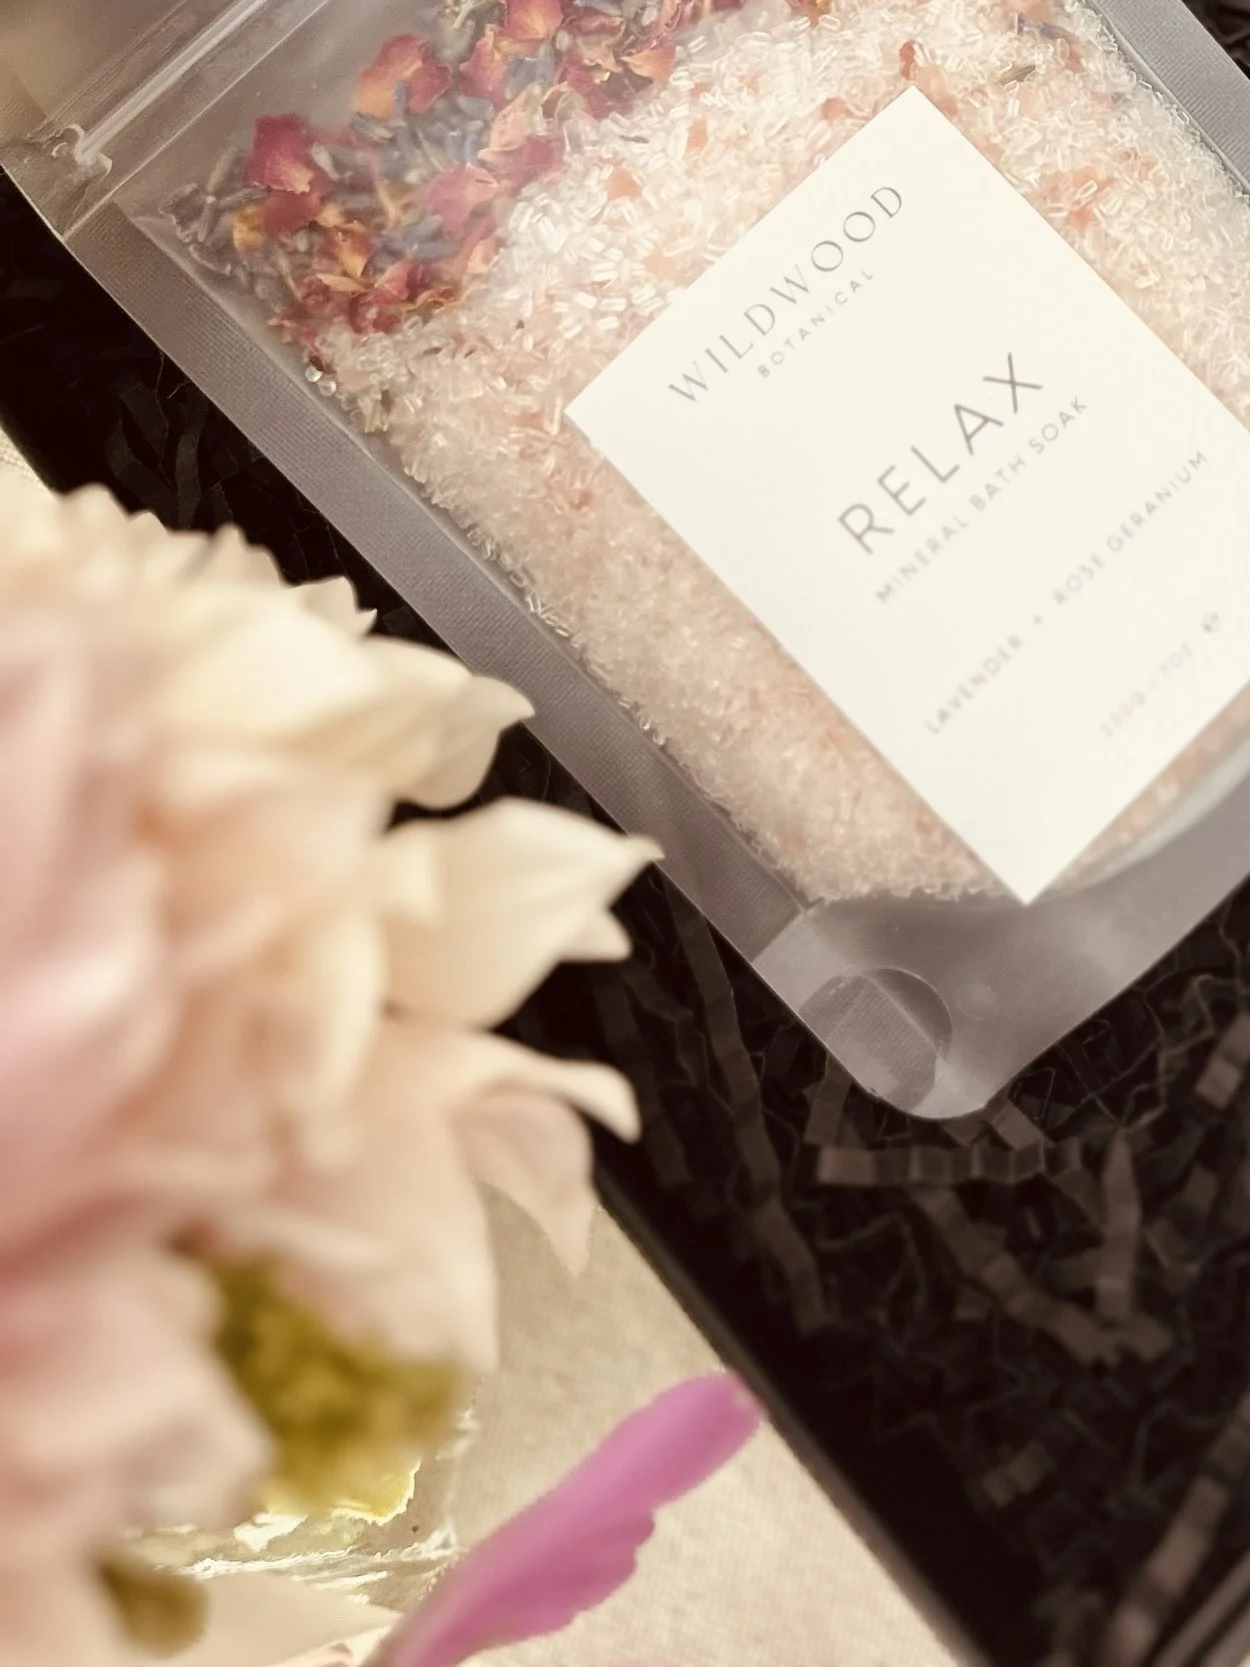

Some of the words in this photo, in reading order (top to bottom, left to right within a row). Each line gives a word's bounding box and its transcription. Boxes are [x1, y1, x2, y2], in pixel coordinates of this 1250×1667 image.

[667, 186, 903, 403] WILDWOOD
[757, 269, 875, 378] BOTANICAL
[836, 350, 1044, 556] RELAX
[875, 514, 970, 604] MINERAL
[969, 454, 1027, 513] BATH
[1028, 395, 1088, 455] SOAK
[925, 633, 1023, 736] LAVENDER
[1052, 551, 1105, 606] ROSE
[1106, 450, 1208, 553] GERANIUM
